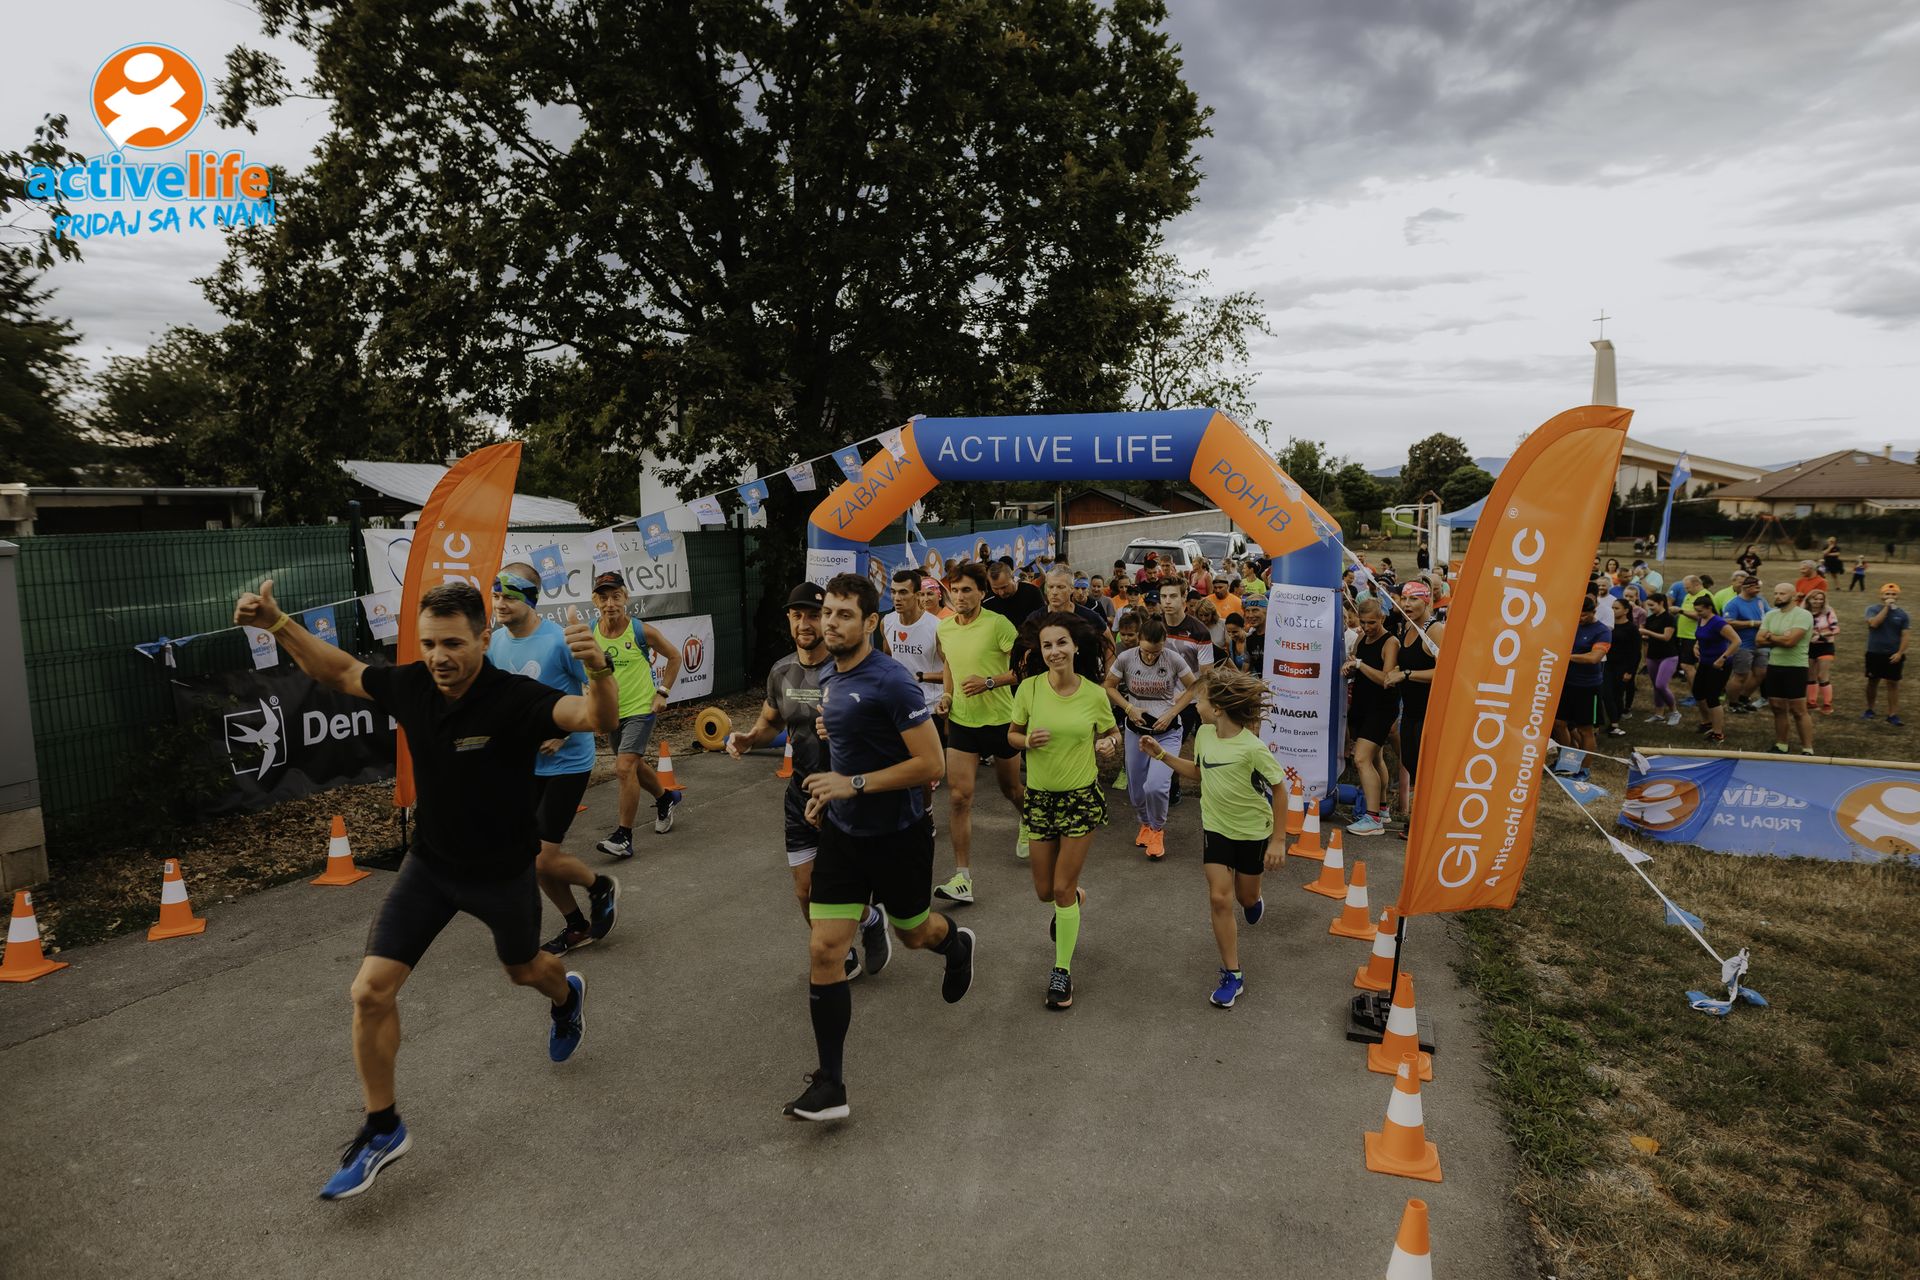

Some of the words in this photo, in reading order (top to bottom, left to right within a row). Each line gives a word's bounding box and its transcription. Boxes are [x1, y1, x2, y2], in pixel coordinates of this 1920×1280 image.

[938, 435, 1073, 463] ACTIVE
[1095, 434, 1173, 464] LIFE
[829, 455, 912, 531] ZABAVA
[1208, 458, 1292, 532] POHYB
[1284, 616, 1324, 629] KOŠICE
[893, 643, 923, 655] PEREŠ
[680, 673, 707, 684] WILLCOM
[1522, 648, 1559, 742] Company
[1280, 708, 1318, 718] MAGNA
[1437, 527, 1547, 889] GlobalLogic
[303, 710, 374, 746] Den
[1508, 741, 1536, 803] Group
[1494, 808, 1524, 870] Hitachi
[1489, 876, 1501, 888] A
